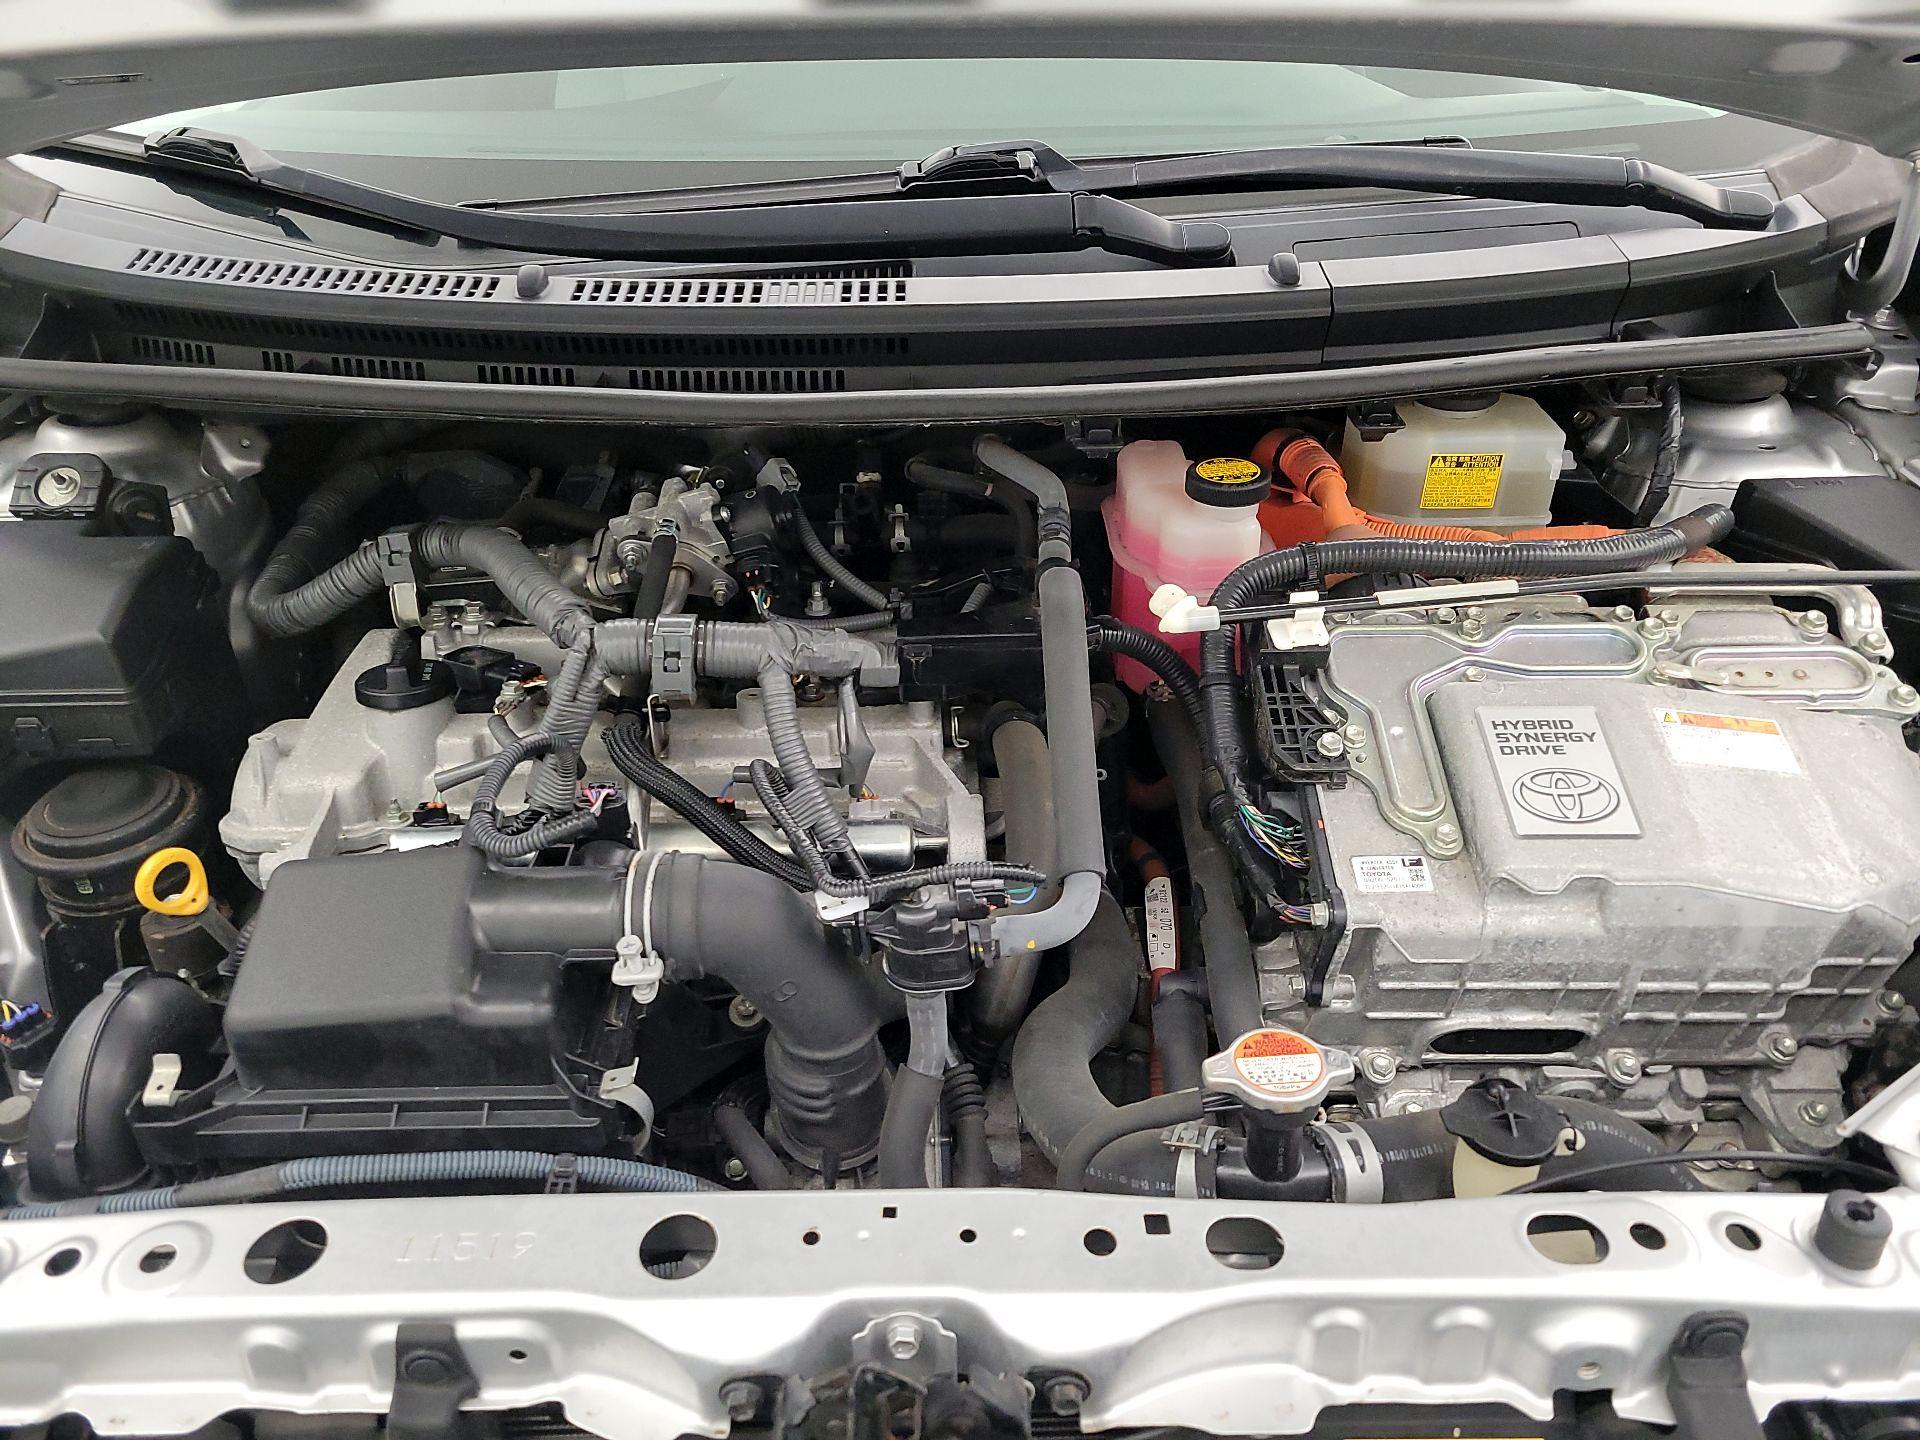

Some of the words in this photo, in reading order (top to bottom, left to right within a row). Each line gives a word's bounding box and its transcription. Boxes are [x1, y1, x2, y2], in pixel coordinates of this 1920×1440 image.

[1491, 719, 1574, 730] HYBRID
[1495, 732, 1596, 743] SYNERGY
[1499, 745, 1567, 755] DRIVE
[1160, 918, 1173, 931] 070
[396, 1232, 537, 1262] 11519
